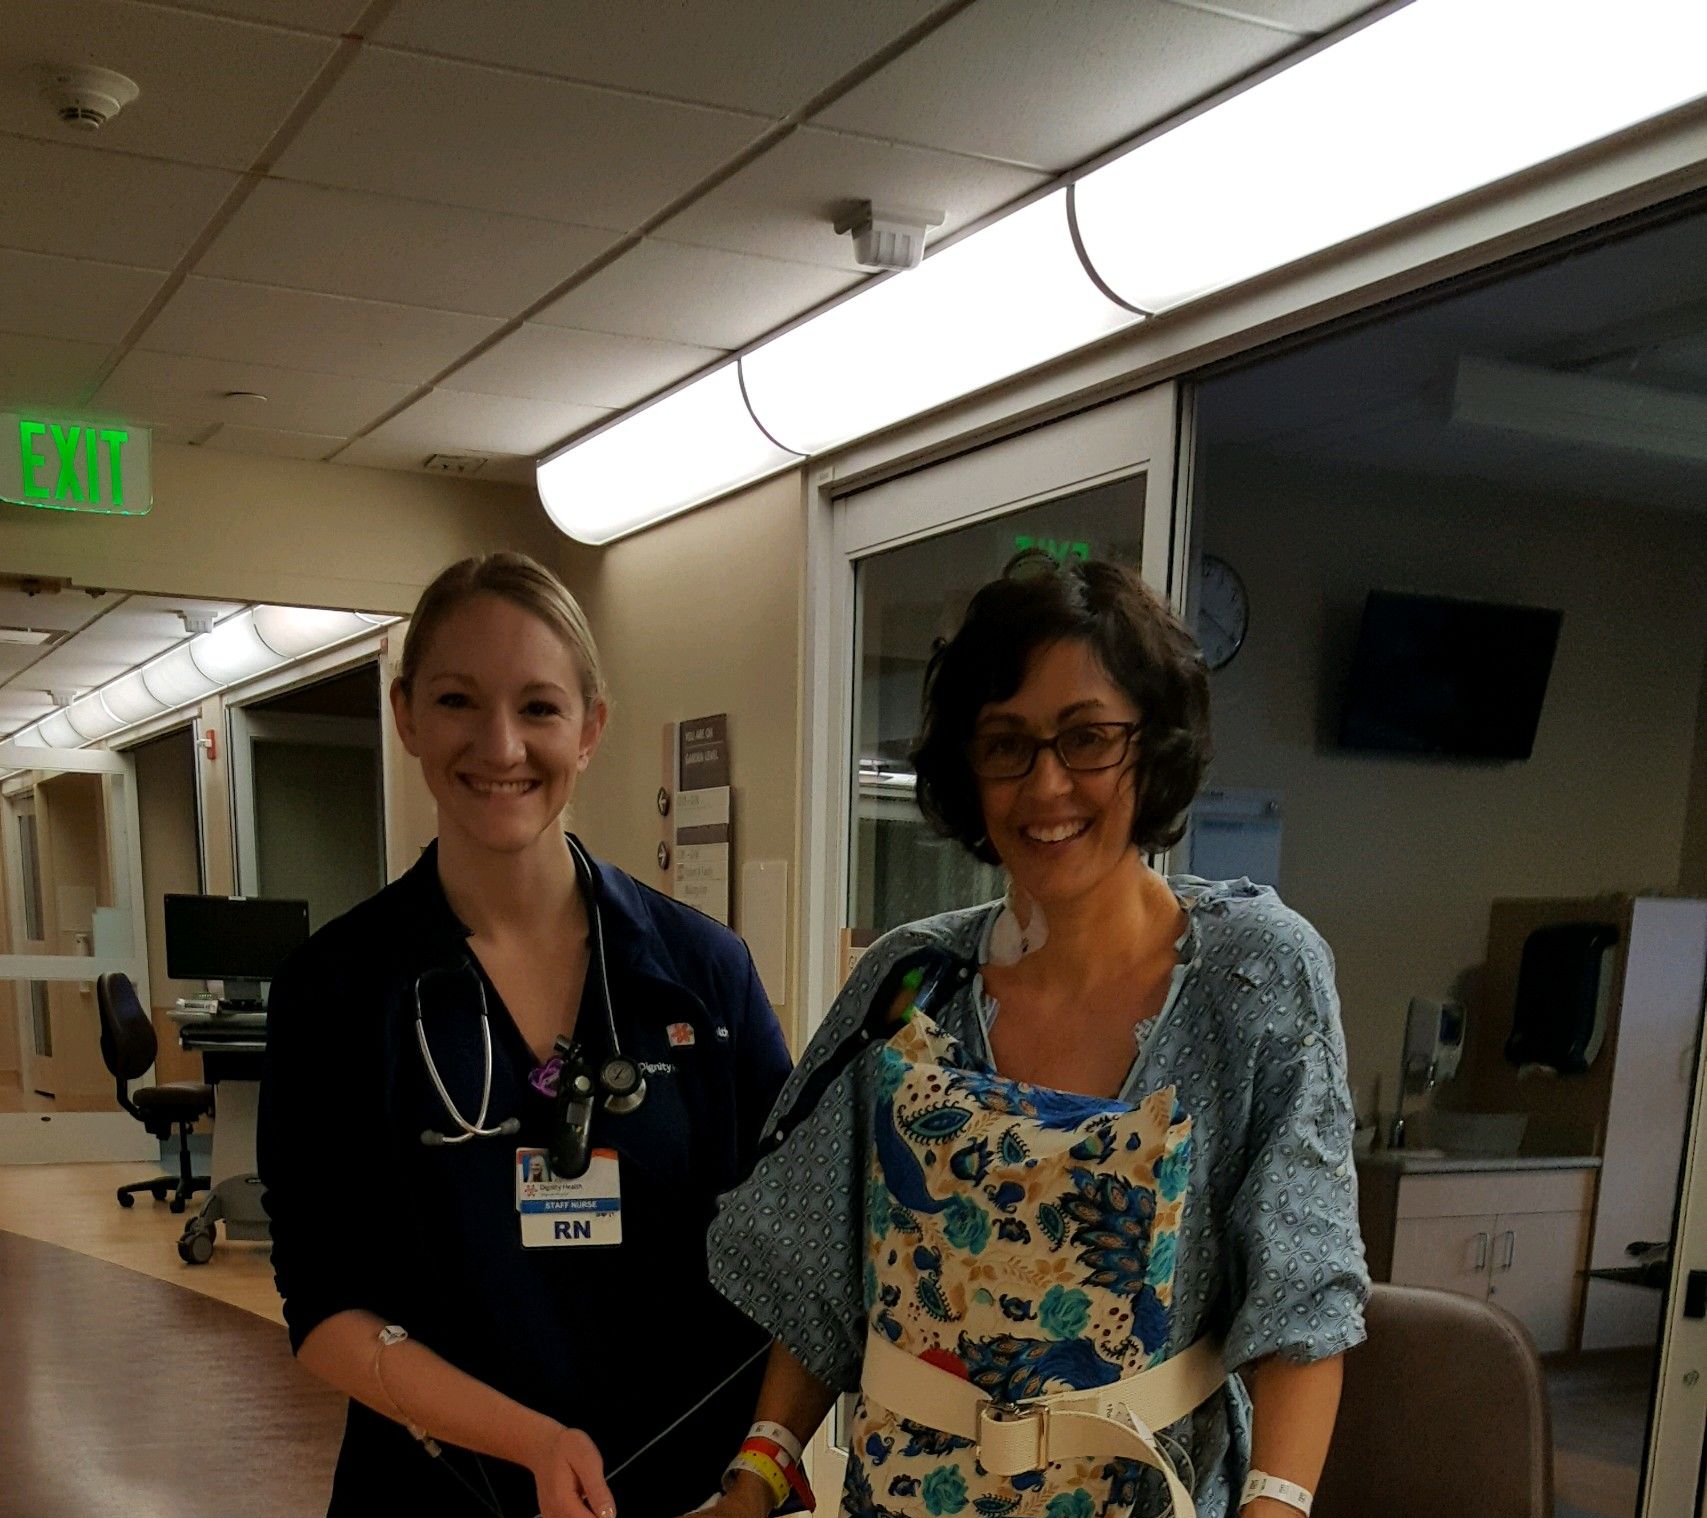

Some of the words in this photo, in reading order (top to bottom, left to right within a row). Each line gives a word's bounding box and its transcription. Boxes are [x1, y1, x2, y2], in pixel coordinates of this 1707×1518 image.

[20, 421, 128, 506] EXIT
[638, 1062, 672, 1074] Dignity
[540, 1184, 561, 1192] Dignity
[571, 1201, 597, 1209] NURSE
[555, 1220, 591, 1239] RN
